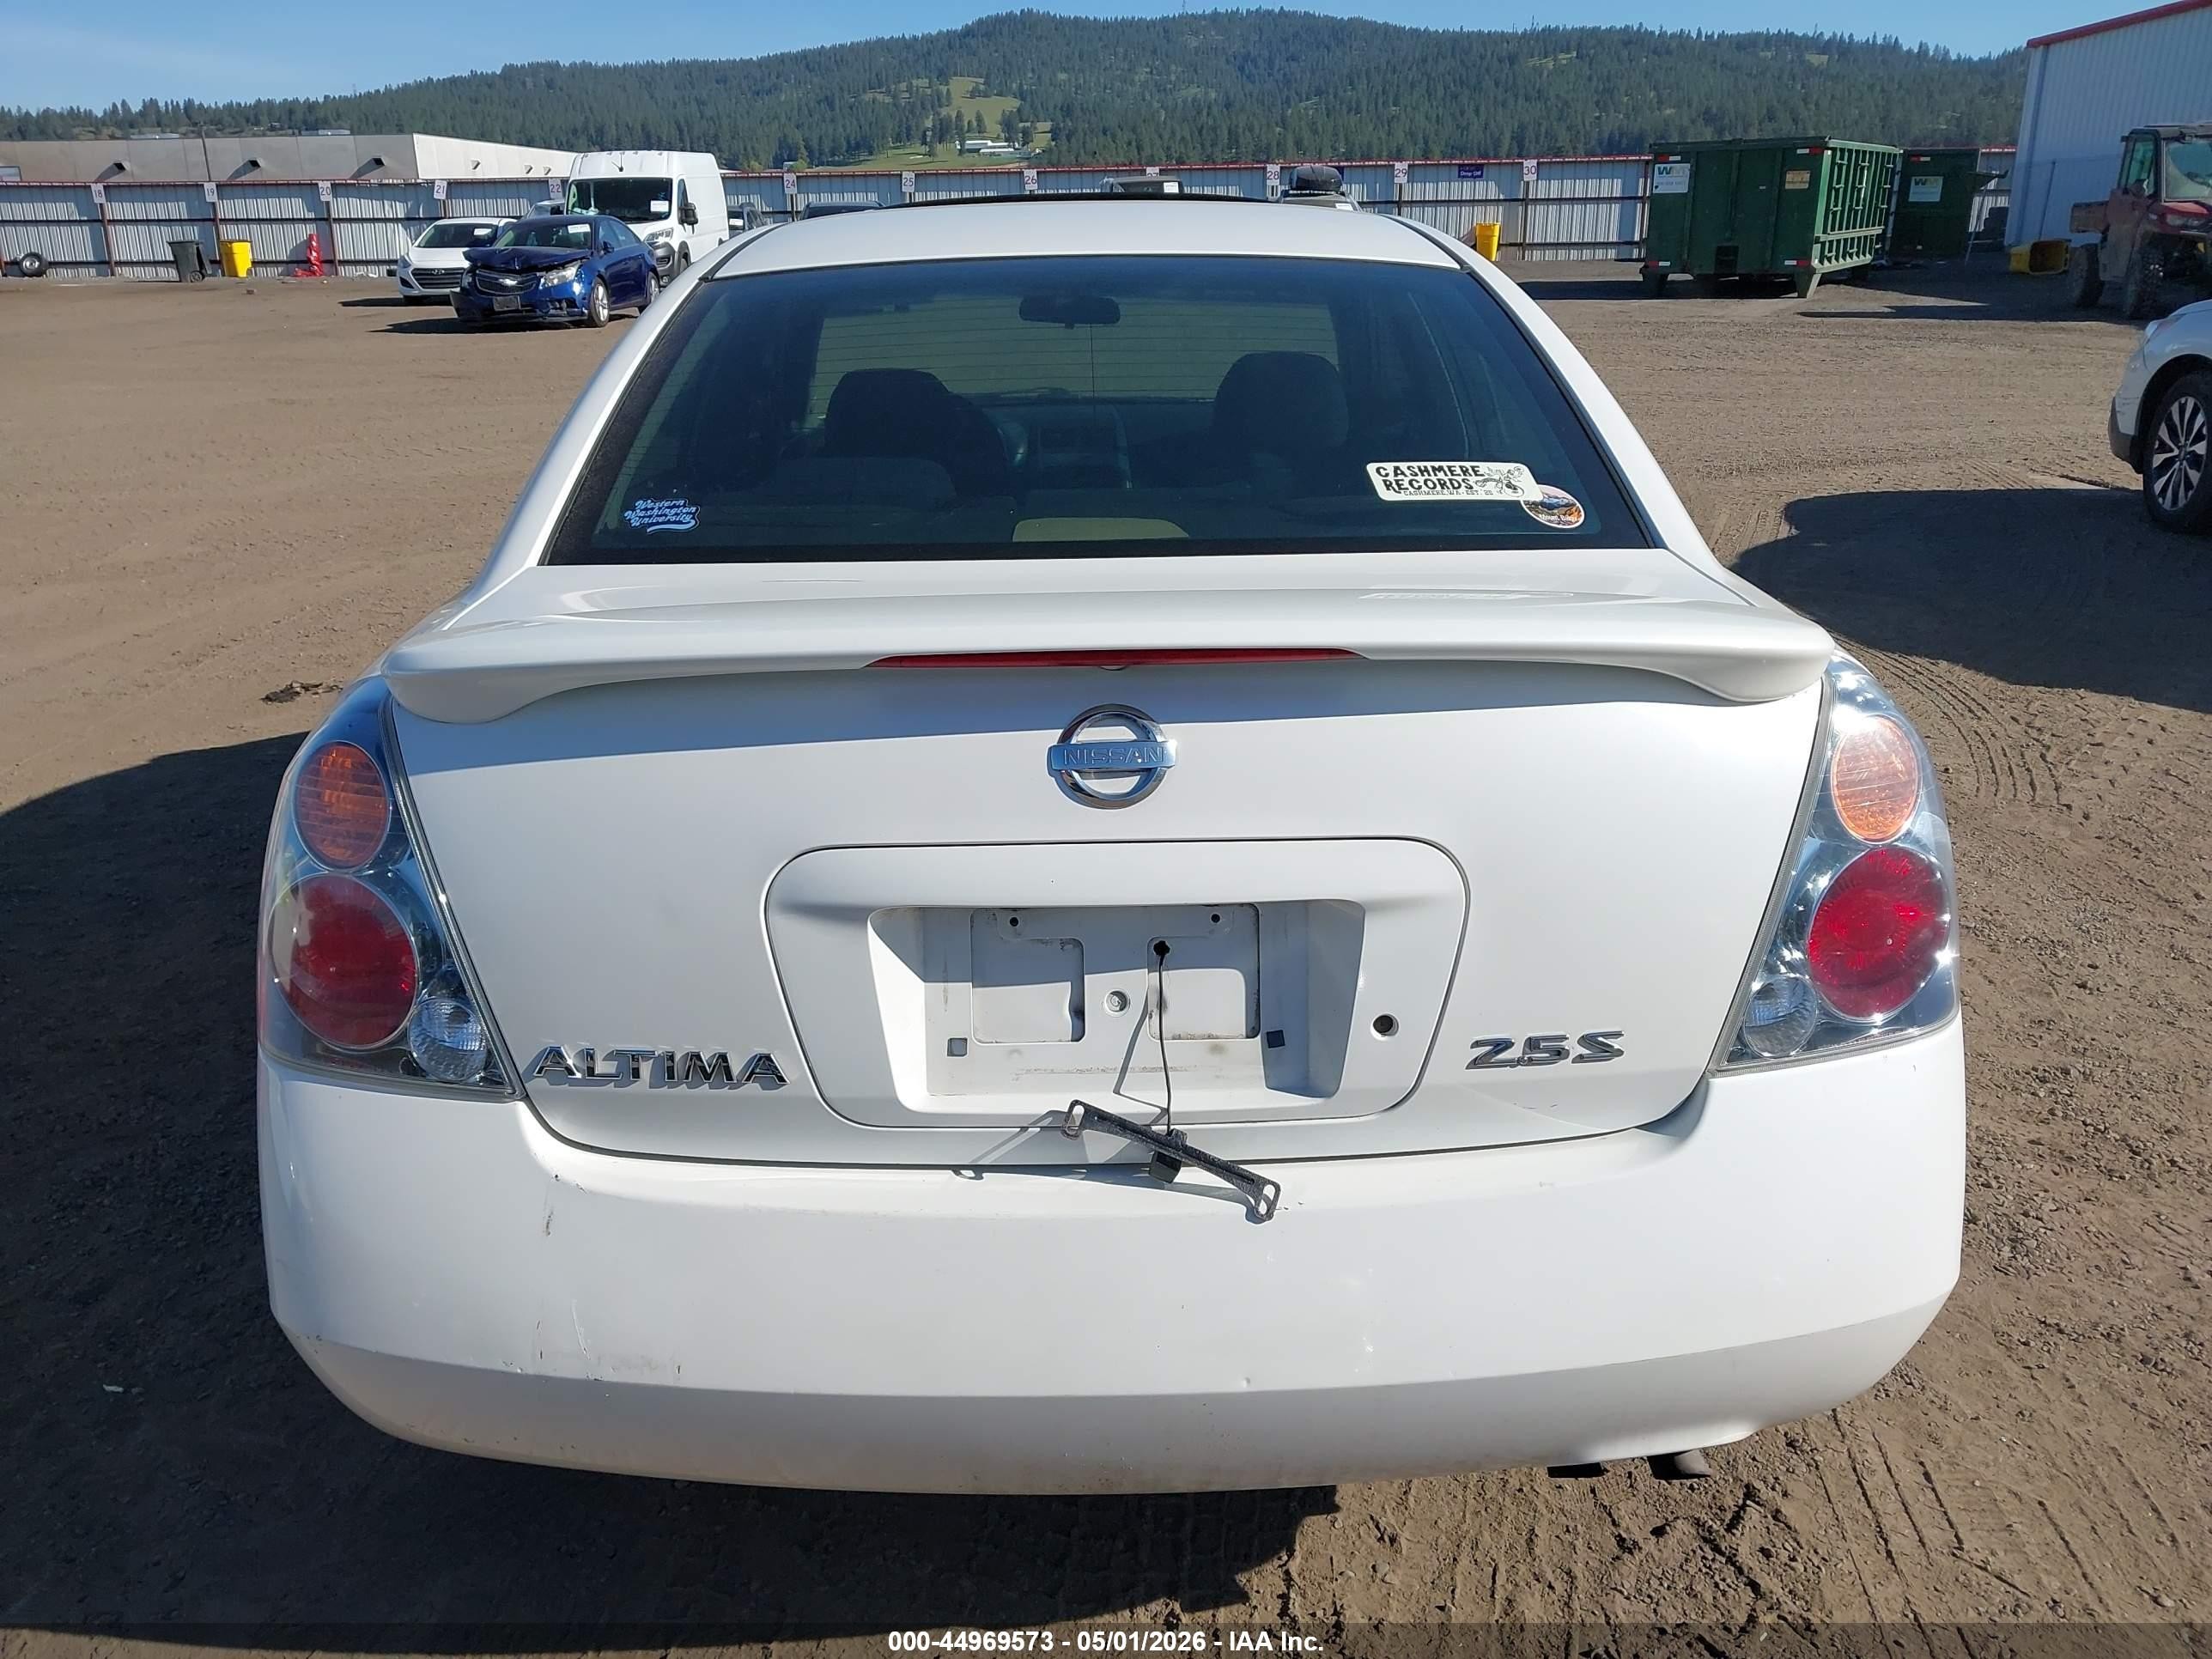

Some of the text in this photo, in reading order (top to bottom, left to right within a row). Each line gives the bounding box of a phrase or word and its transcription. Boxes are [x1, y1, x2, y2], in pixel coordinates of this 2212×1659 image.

[1395, 168, 1407, 178] 29
[1524, 165, 1537, 175] 30
[1024, 175, 1036, 185] 26
[1267, 171, 1279, 180] 28
[785, 179, 795, 189] 24
[903, 177, 914, 186] 25
[94, 189, 103, 198] 18
[206, 188, 215, 197] 19
[320, 186, 331, 196] 20
[436, 185, 445, 194] 21
[550, 184, 561, 193] 22
[1376, 465, 1485, 477] CASHMERE
[1382, 478, 1474, 494] RECORDS
[635, 500, 685, 509] Western
[624, 507, 697, 520] Washington
[630, 514, 693, 526] University
[1064, 747, 1164, 765] NISSAN
[534, 1046, 791, 1085] ALTIMA
